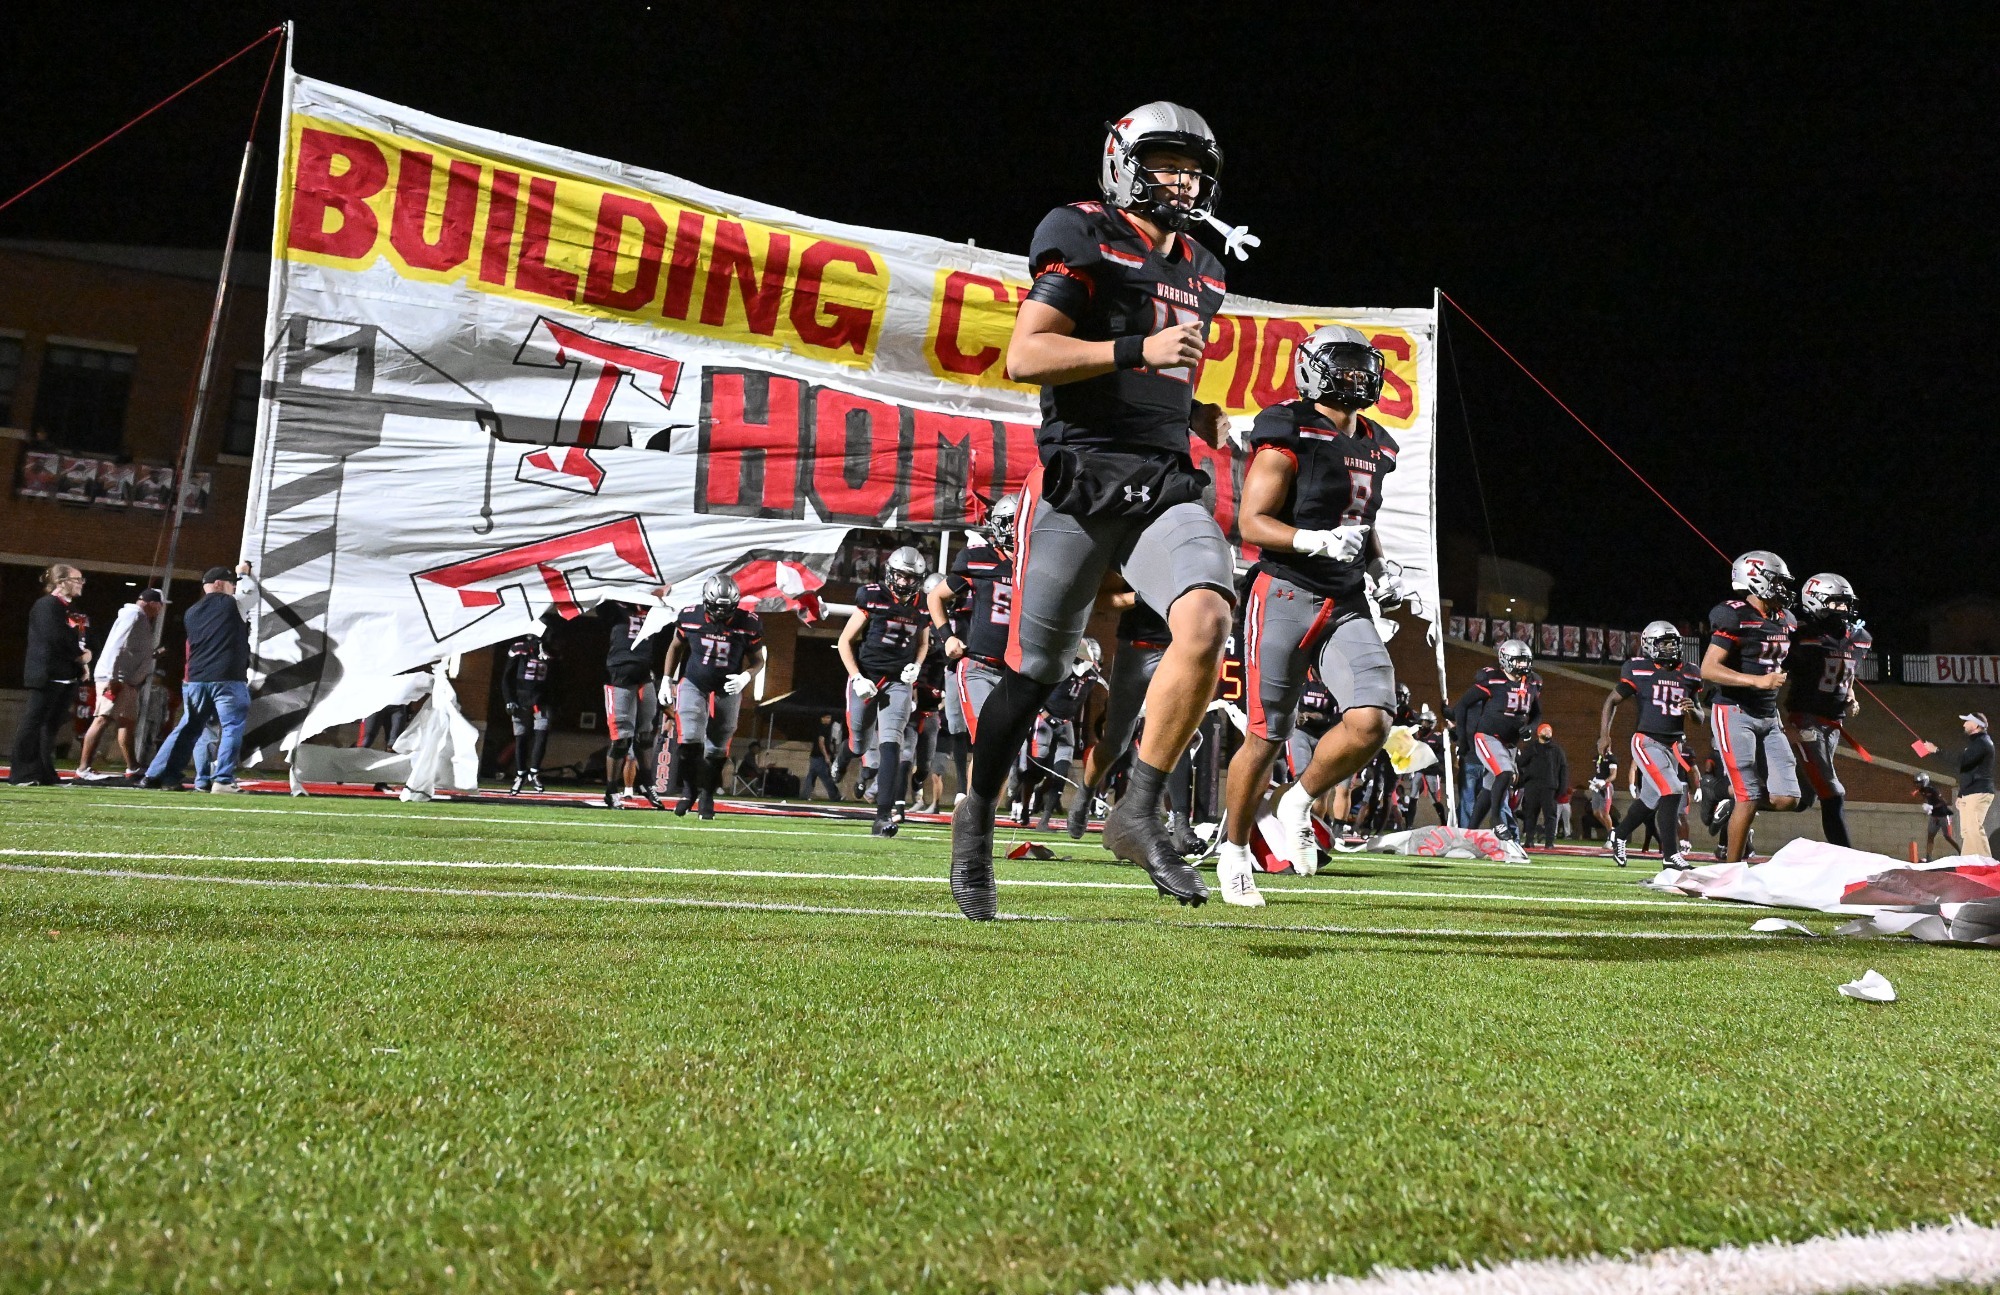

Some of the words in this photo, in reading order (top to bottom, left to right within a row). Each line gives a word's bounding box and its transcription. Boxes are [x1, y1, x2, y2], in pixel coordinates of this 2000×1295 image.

[287, 128, 878, 356] BUILDING
[934, 271, 1414, 420] CPIOS
[1156, 282, 1199, 308] WARRIORS
[1343, 456, 1377, 473] WARRIORS
[1936, 655, 2000, 684] BUILT
